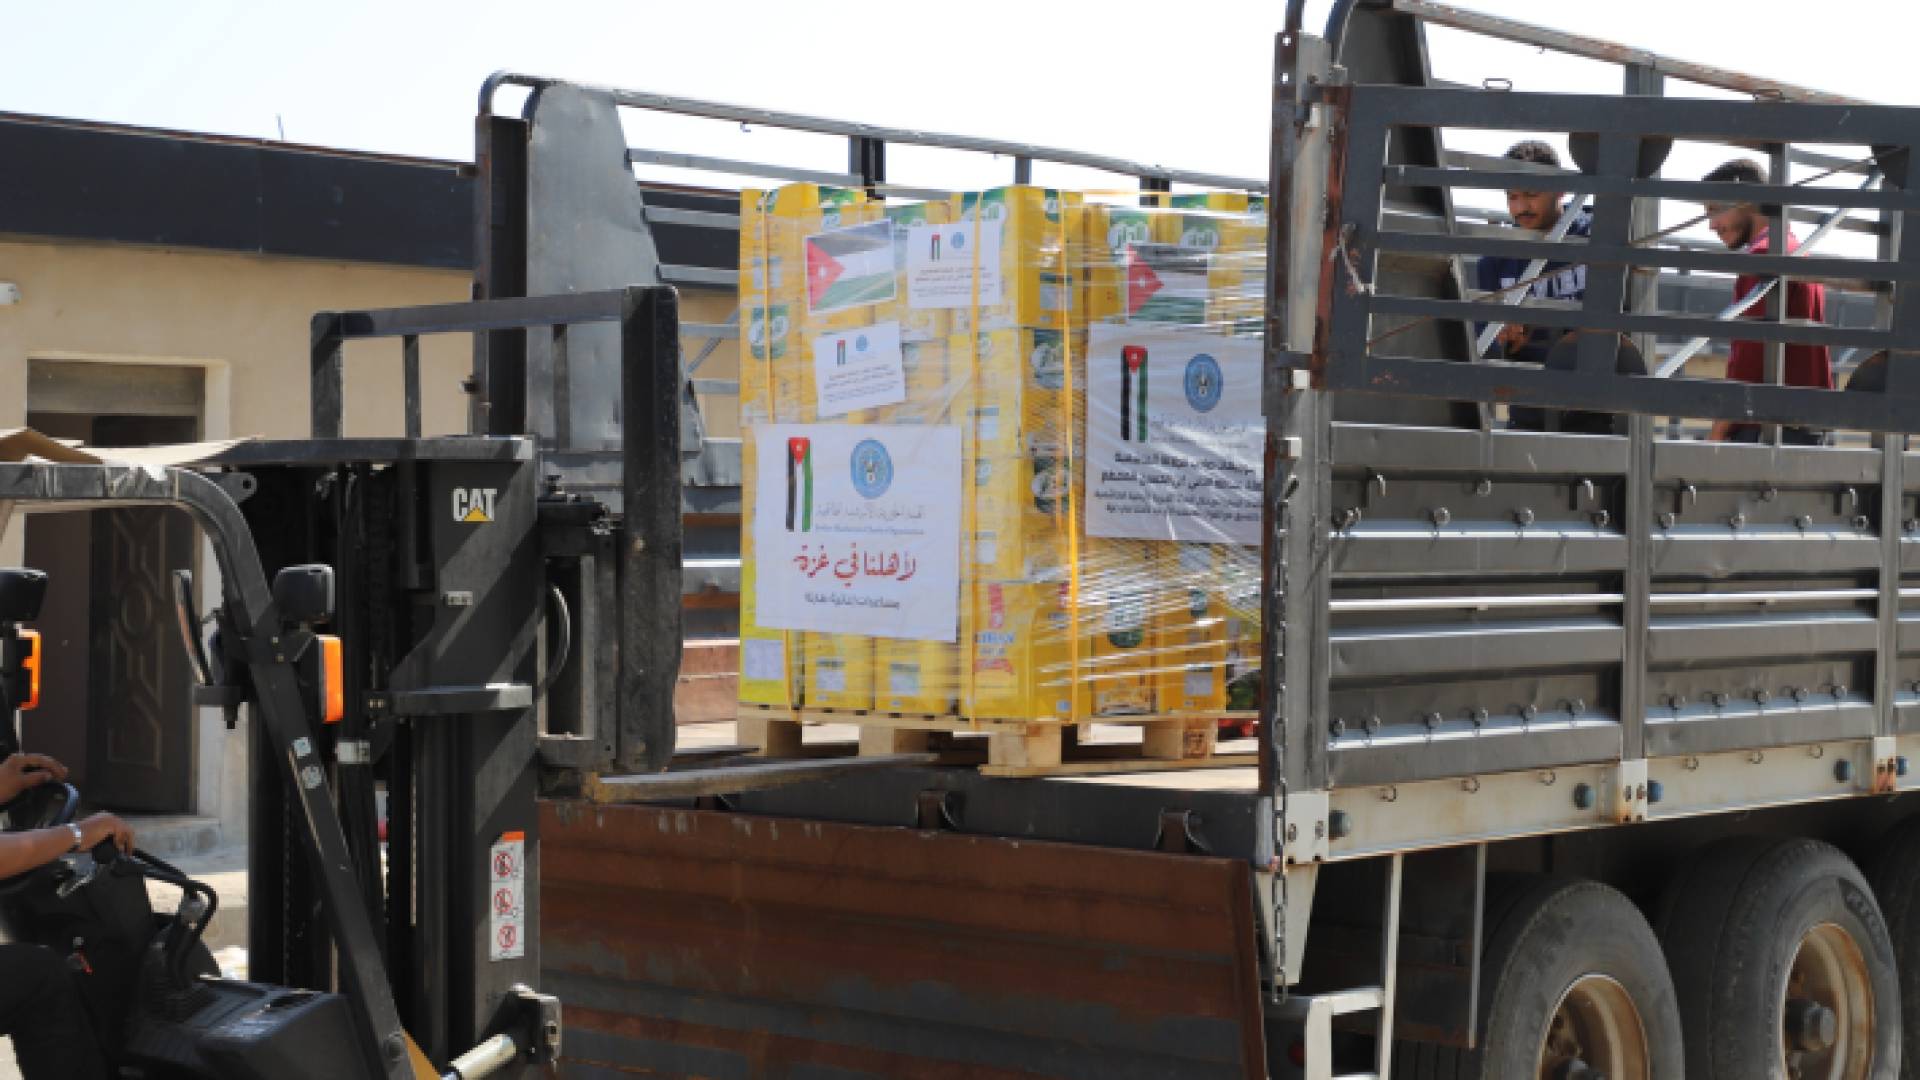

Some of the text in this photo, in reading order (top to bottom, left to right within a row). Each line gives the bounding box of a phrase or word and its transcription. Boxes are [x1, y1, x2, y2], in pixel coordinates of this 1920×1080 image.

[453, 488, 497, 521] CAT
[793, 542, 916, 588] لأهلنا في غزة
